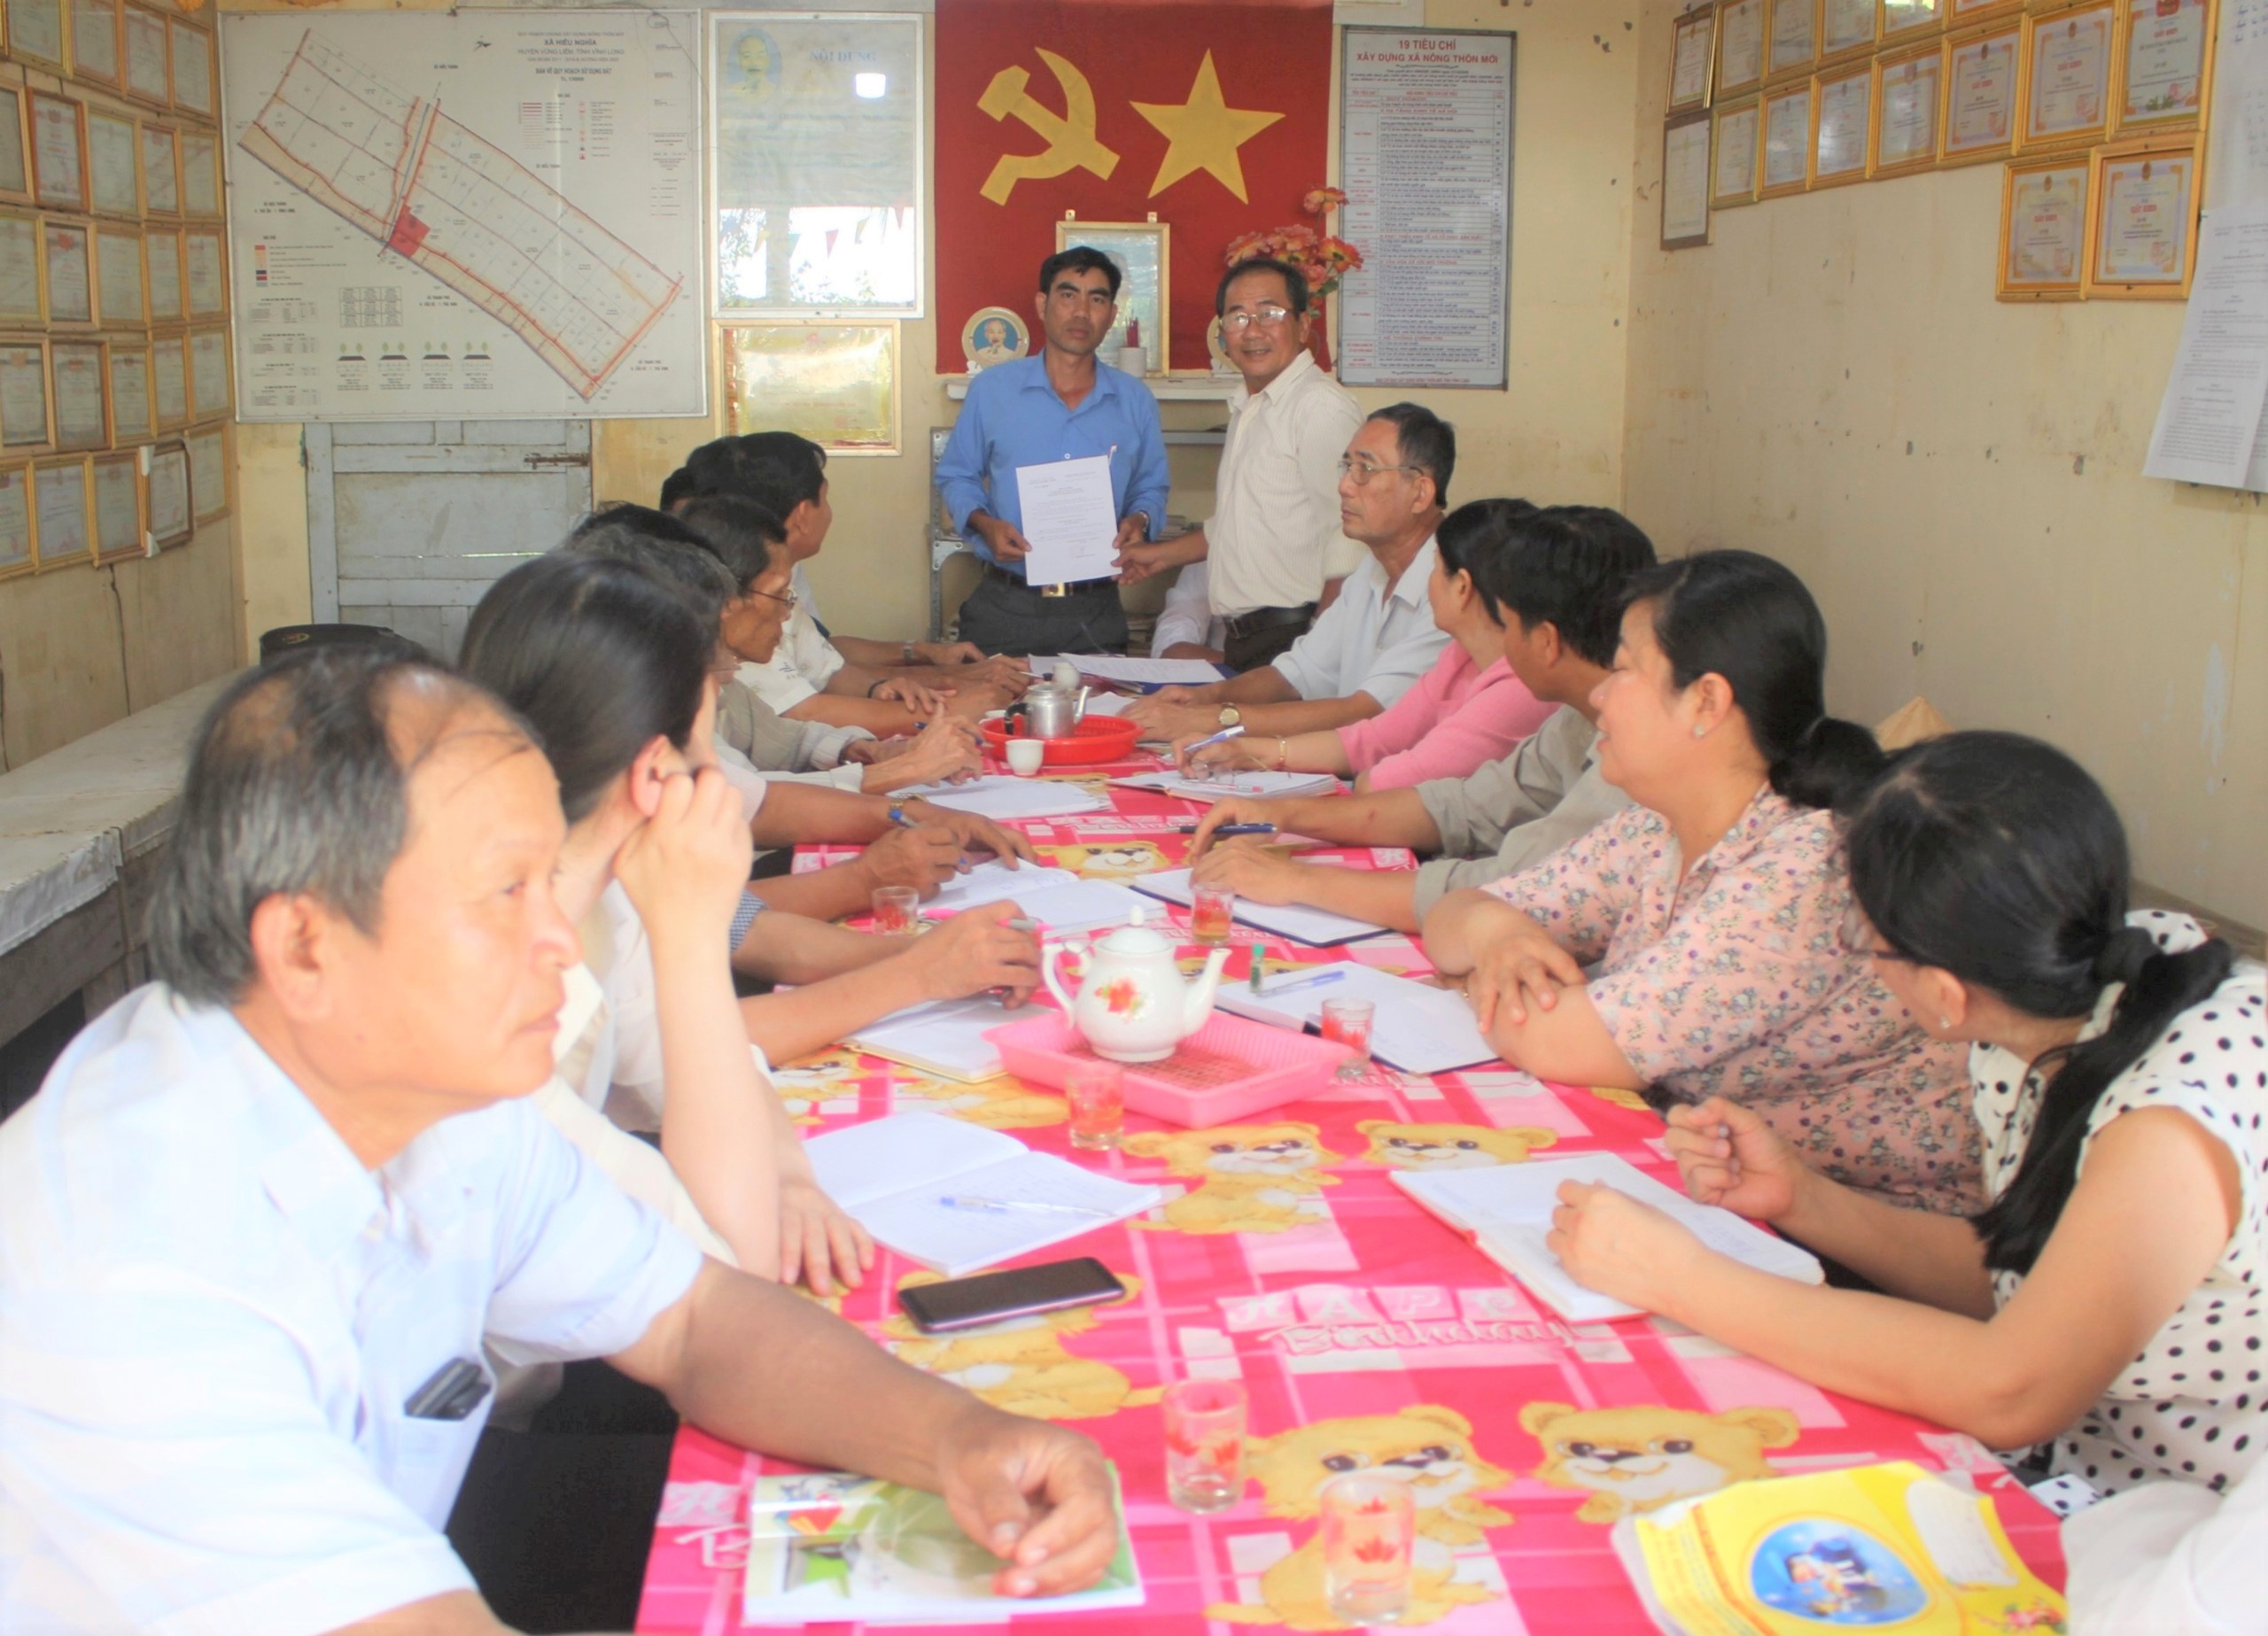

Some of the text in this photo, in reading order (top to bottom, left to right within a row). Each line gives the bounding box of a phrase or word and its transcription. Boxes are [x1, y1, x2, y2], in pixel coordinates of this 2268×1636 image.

[1399, 37, 1456, 50] 19 TIÊU CHÍ
[1356, 52, 1498, 64] XÂY DỰNG XÃ NÔNG THÔN MỚI
[1228, 1291, 1517, 1323] HAPP
